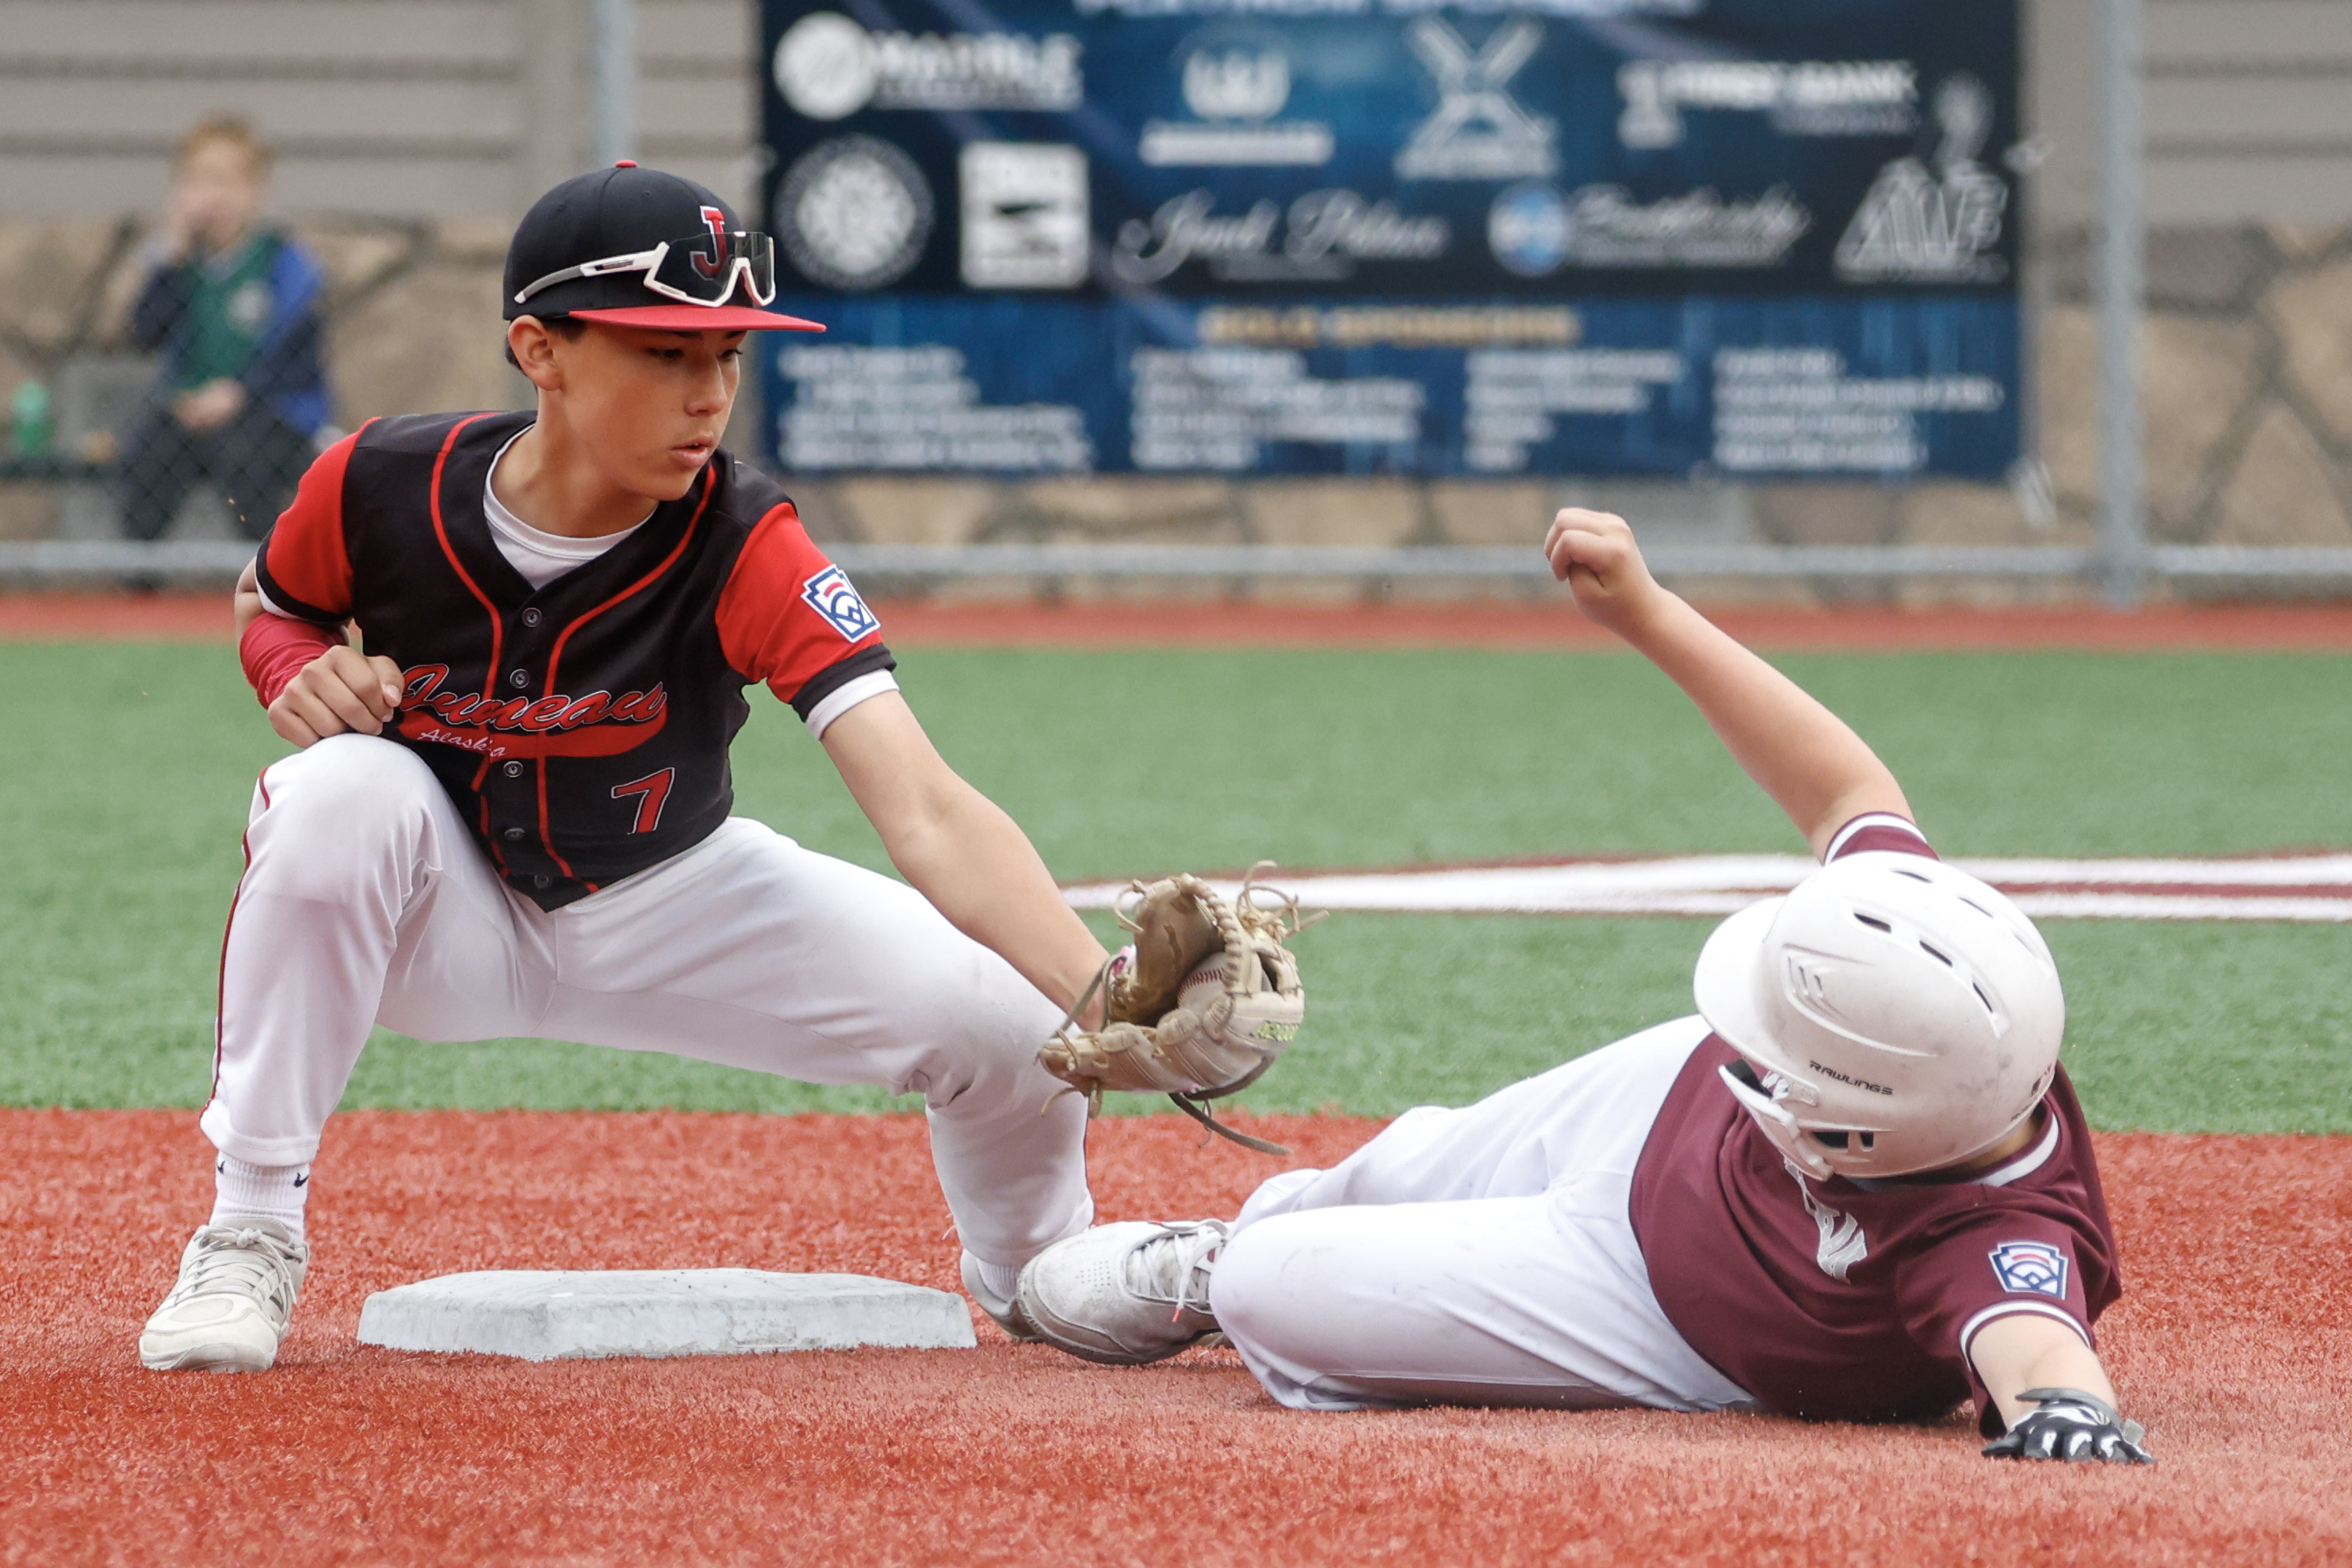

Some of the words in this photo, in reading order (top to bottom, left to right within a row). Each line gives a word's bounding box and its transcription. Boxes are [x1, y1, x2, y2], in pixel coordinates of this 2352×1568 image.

[690, 205, 728, 281] J
[400, 663, 667, 732] Juneau
[417, 728, 507, 759] Alaska
[610, 767, 675, 836] 7
[1808, 1059, 1895, 1096] RAWLINGS
